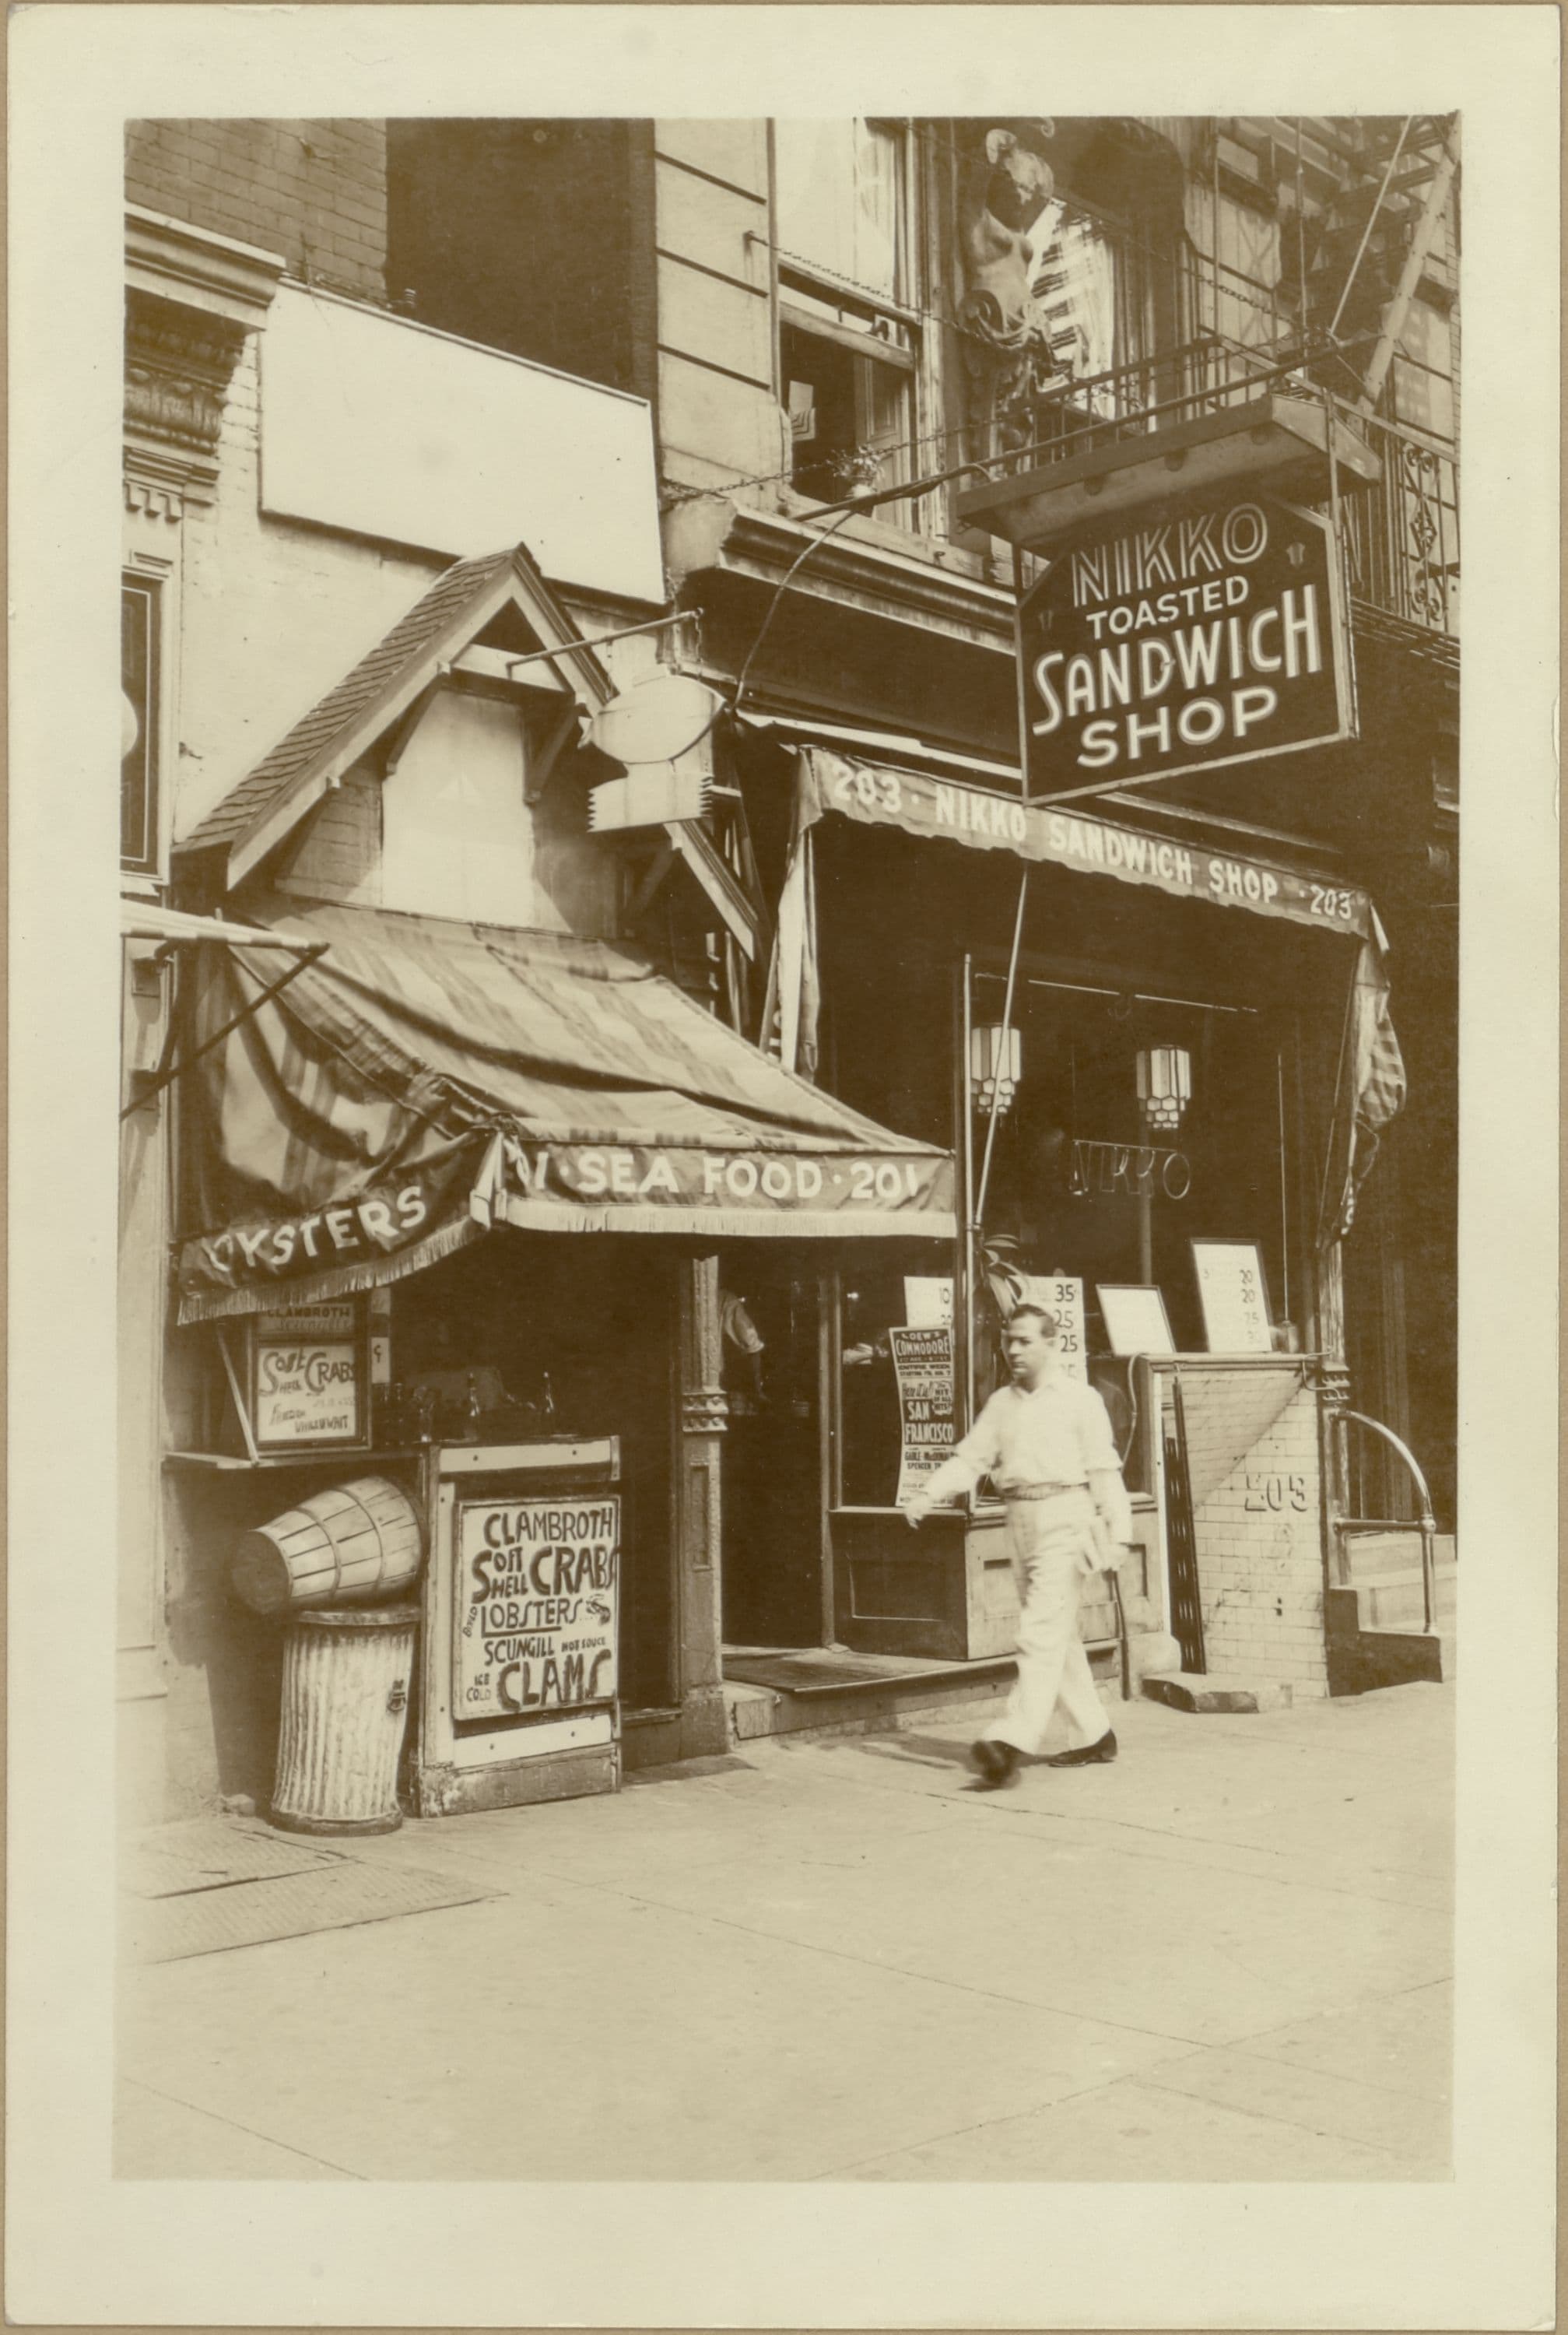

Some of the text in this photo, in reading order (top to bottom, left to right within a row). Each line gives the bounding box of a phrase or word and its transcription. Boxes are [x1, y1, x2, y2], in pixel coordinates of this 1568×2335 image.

[1072, 503, 1268, 608] NIKKO
[1086, 575, 1249, 640] TOASTED
[1033, 585, 1322, 736] SANDWICH
[1077, 686, 1278, 767] SHOP
[833, 767, 1353, 920] 203 NIKKO SANDWICH SHOP 203
[576, 1152, 680, 1195] SEA
[702, 1156, 823, 1199] FOOD
[851, 1161, 919, 1199] 201
[201, 1185, 426, 1273] OYSTERS
[267, 1306, 350, 1318] CLAMBROTH
[1054, 1283, 1075, 1303] 35
[1053, 1309, 1075, 1329] 25
[895, 1336, 950, 1357] COMMODORE
[1059, 1334, 1079, 1354] 25
[907, 1401, 930, 1420] SAN
[905, 1423, 953, 1443] FRANCISCO
[483, 1507, 613, 1549] CLAMBROTH
[529, 1544, 623, 1596] CRABS
[481, 1598, 583, 1638] LOBSTERS
[561, 1639, 580, 1652] HOT
[466, 1687, 491, 1703] COLD
[496, 1649, 612, 1713] CLAMS
